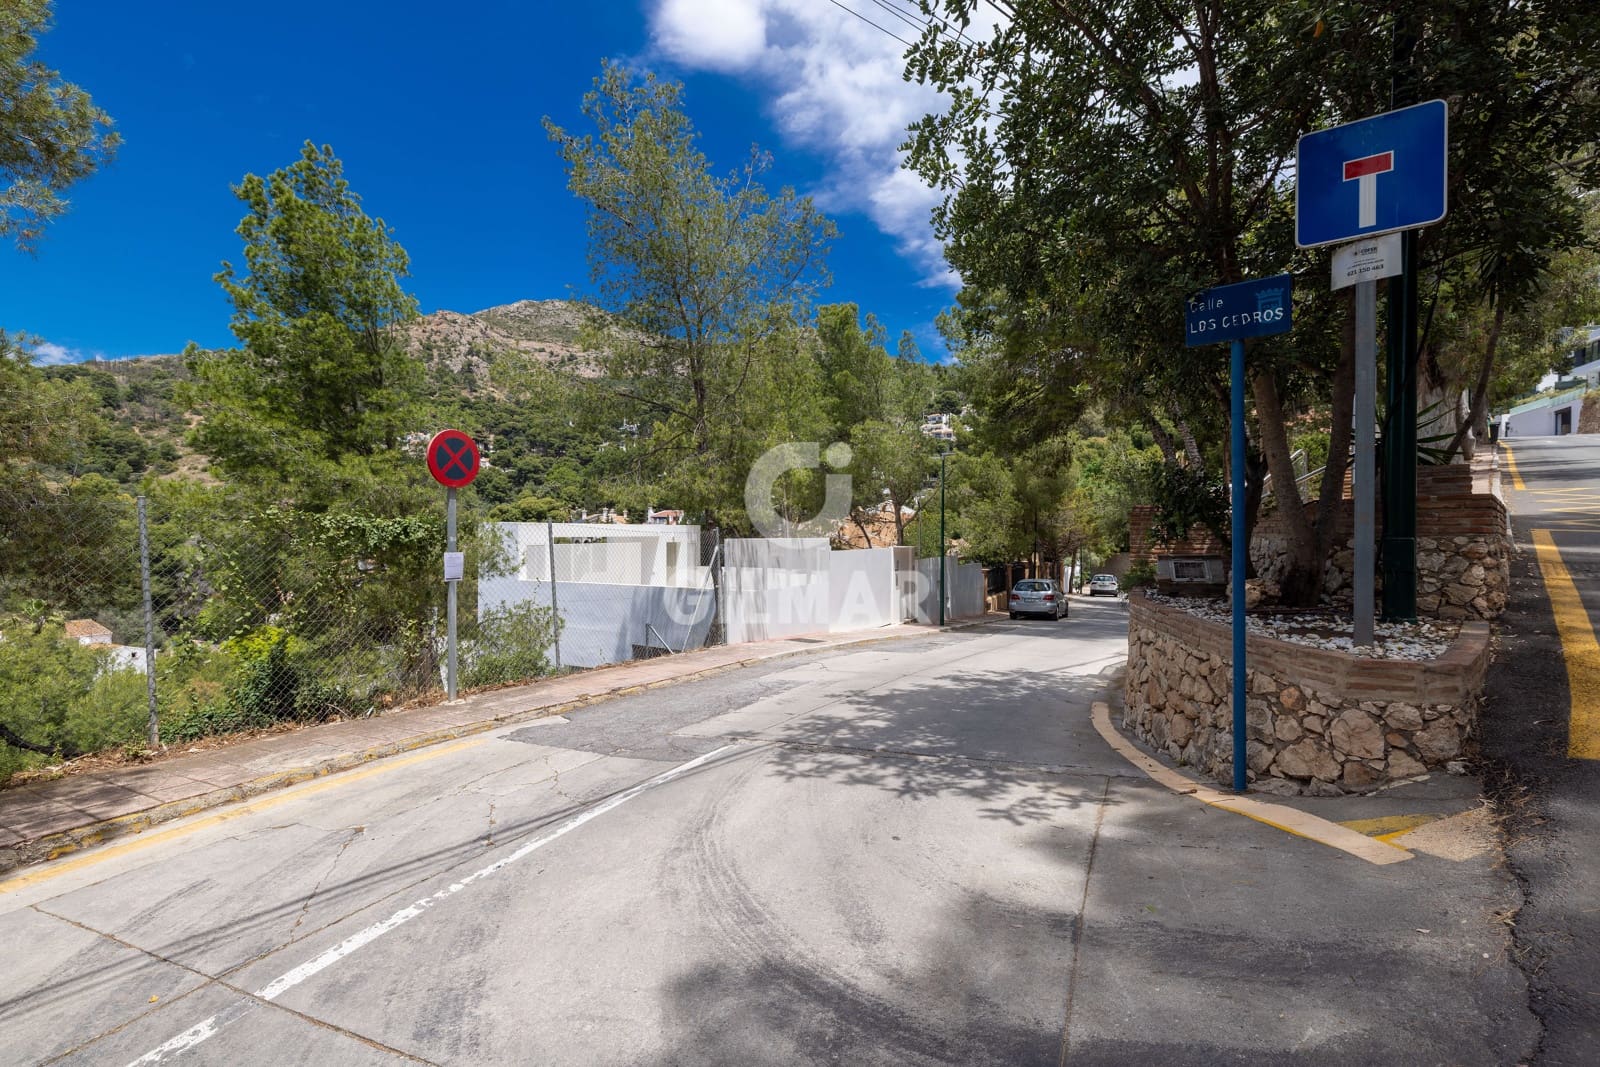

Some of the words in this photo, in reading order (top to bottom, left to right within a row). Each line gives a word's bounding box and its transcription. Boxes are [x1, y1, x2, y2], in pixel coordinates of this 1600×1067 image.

[1190, 299, 1223, 312] Calle
[1190, 318, 1216, 333] LOS
[1222, 307, 1284, 328] CEDROS
